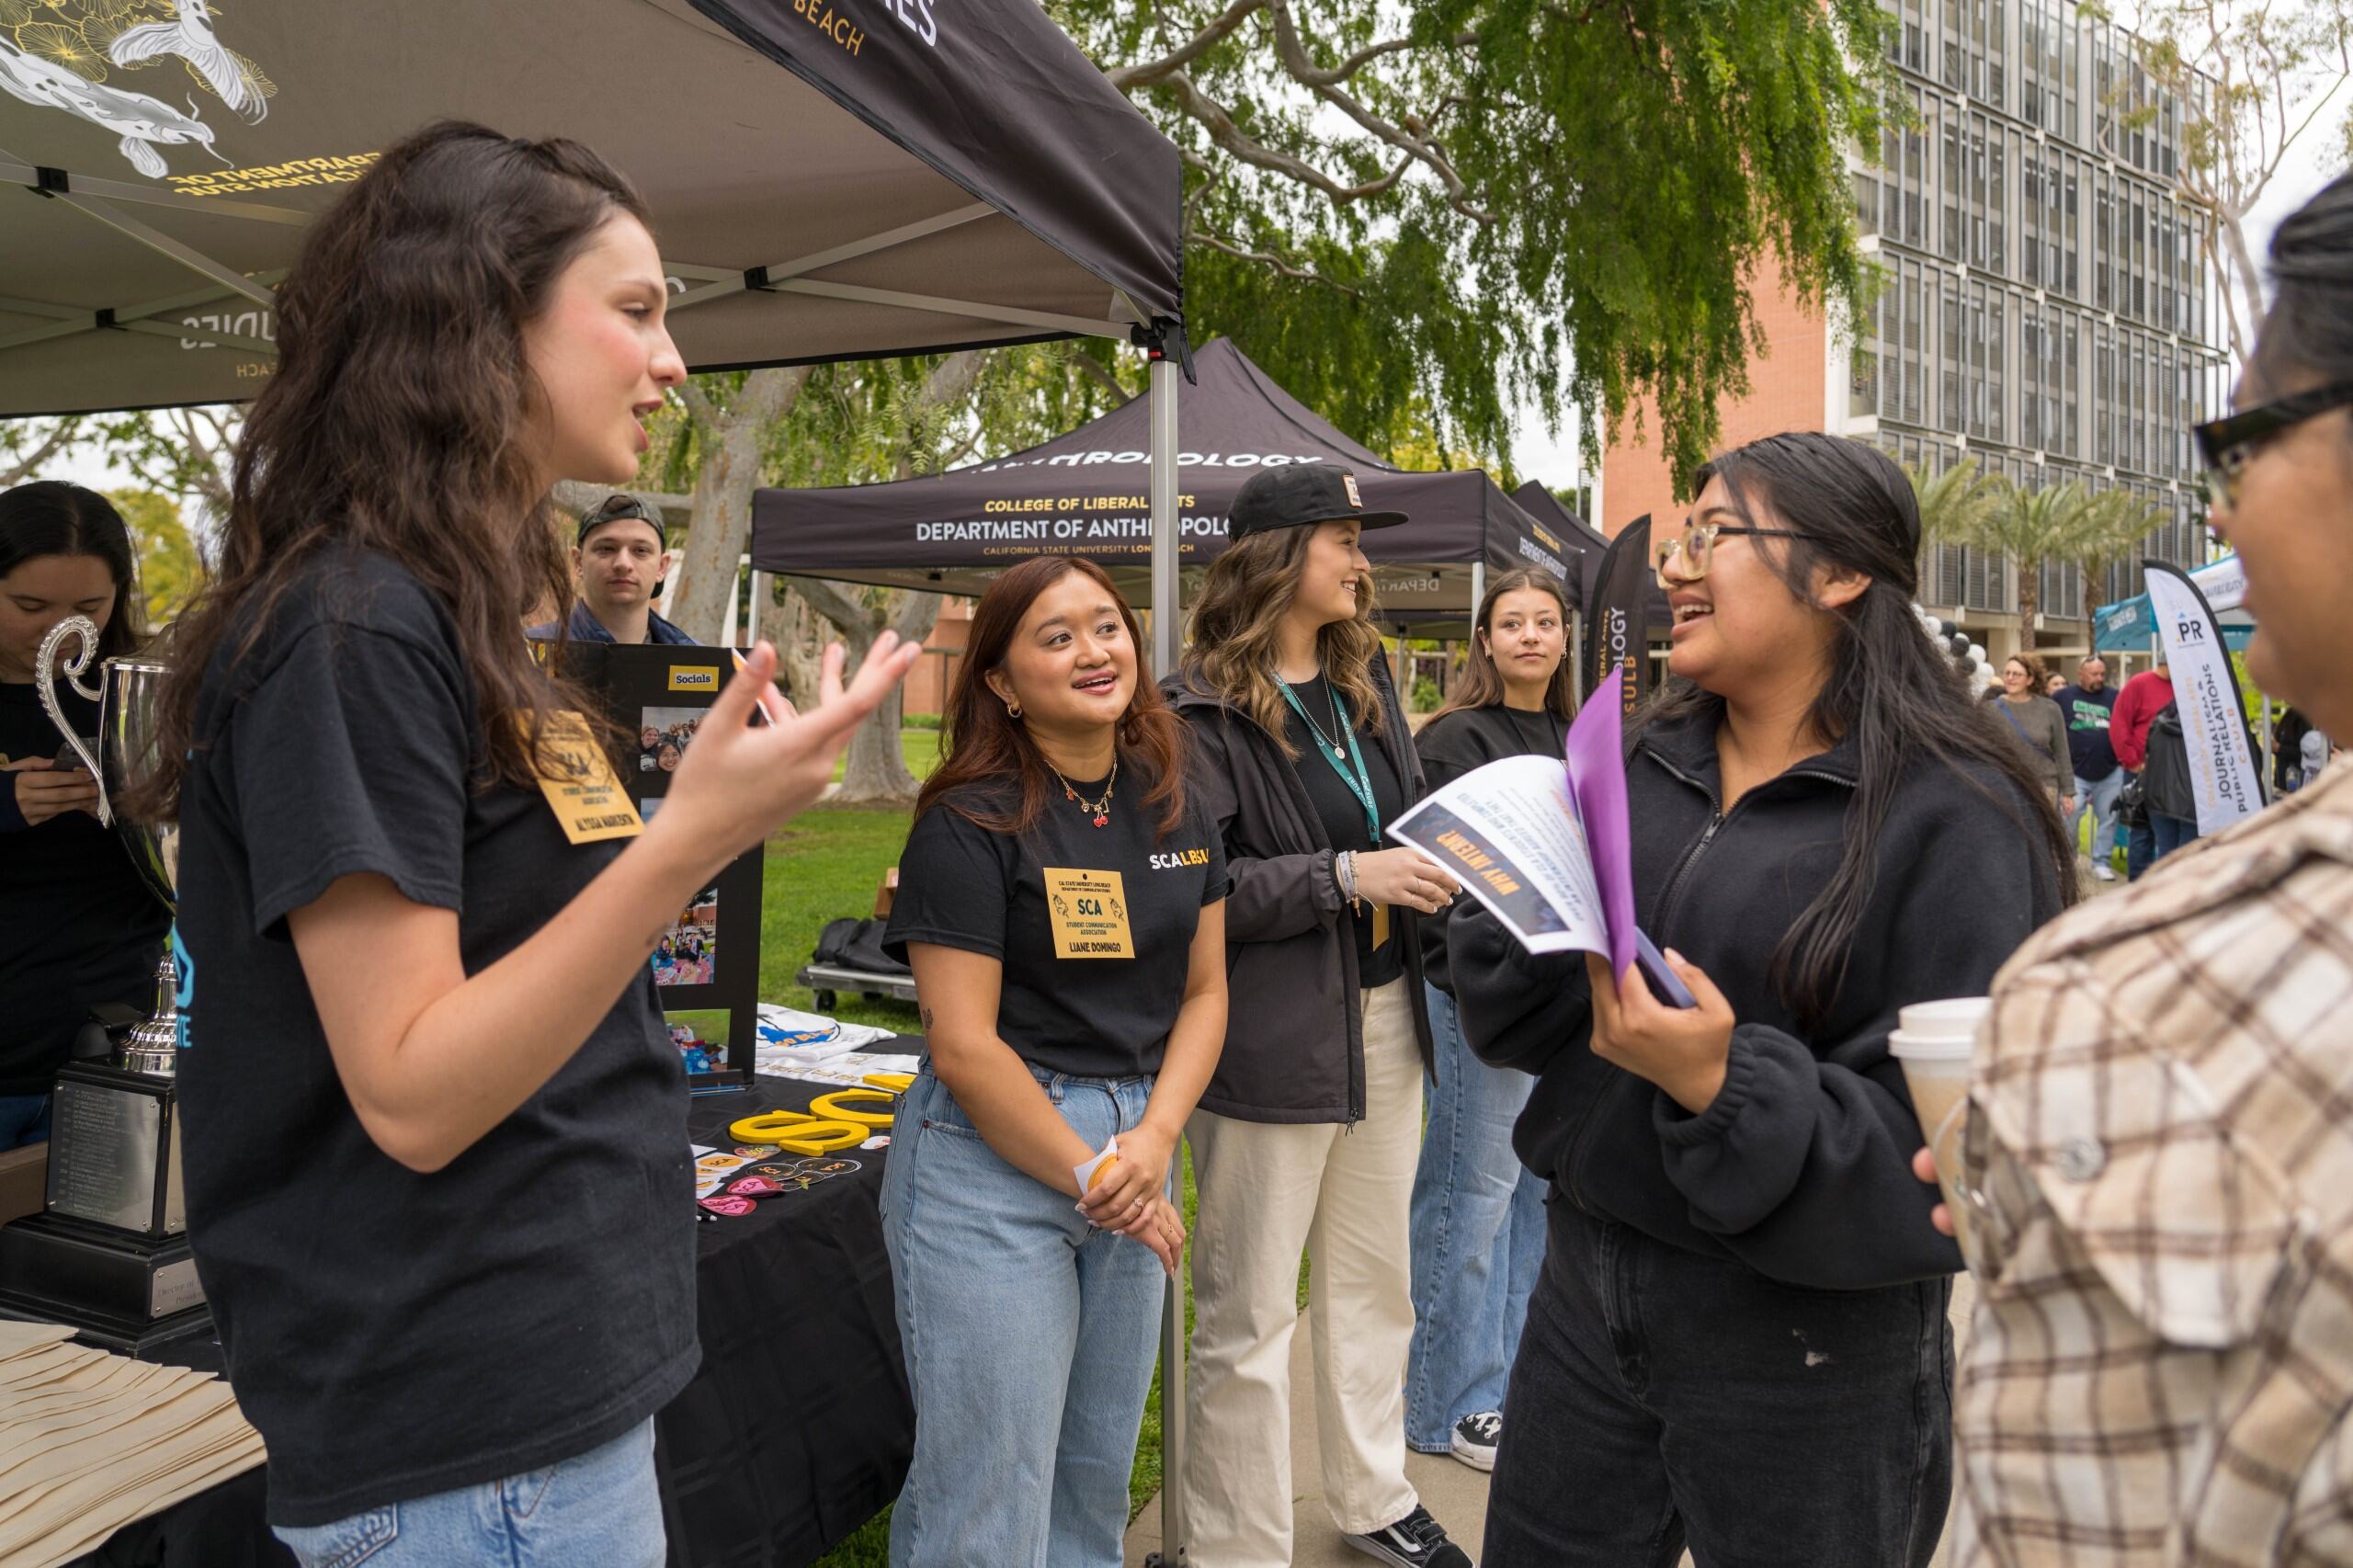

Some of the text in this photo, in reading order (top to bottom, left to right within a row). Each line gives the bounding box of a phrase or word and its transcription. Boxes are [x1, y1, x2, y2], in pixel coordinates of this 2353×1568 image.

[984, 499, 1054, 513] COLLEGE
[1057, 498, 1080, 511] OF
[1083, 495, 1149, 510] LIBERAL
[915, 519, 1051, 541] DEPARTMENT
[1053, 518, 1085, 539] OF
[983, 546, 1040, 556] CALIFORNIA
[1042, 545, 1068, 555] STATE
[1072, 544, 1129, 554] UNIVERSITY
[1131, 544, 1152, 553] LON
[2177, 619, 2204, 642] PR
[676, 674, 711, 684] Socials
[2201, 697, 2232, 800] JOURNALISM
[2202, 663, 2248, 813] PUBLIC RELATIONS
[1149, 847, 1210, 870] SCALBSU
[1436, 830, 1521, 896] WHY INTERN?
[1077, 898, 1103, 916] SCA
[1069, 942, 1121, 953] LIANE DOMINGO
